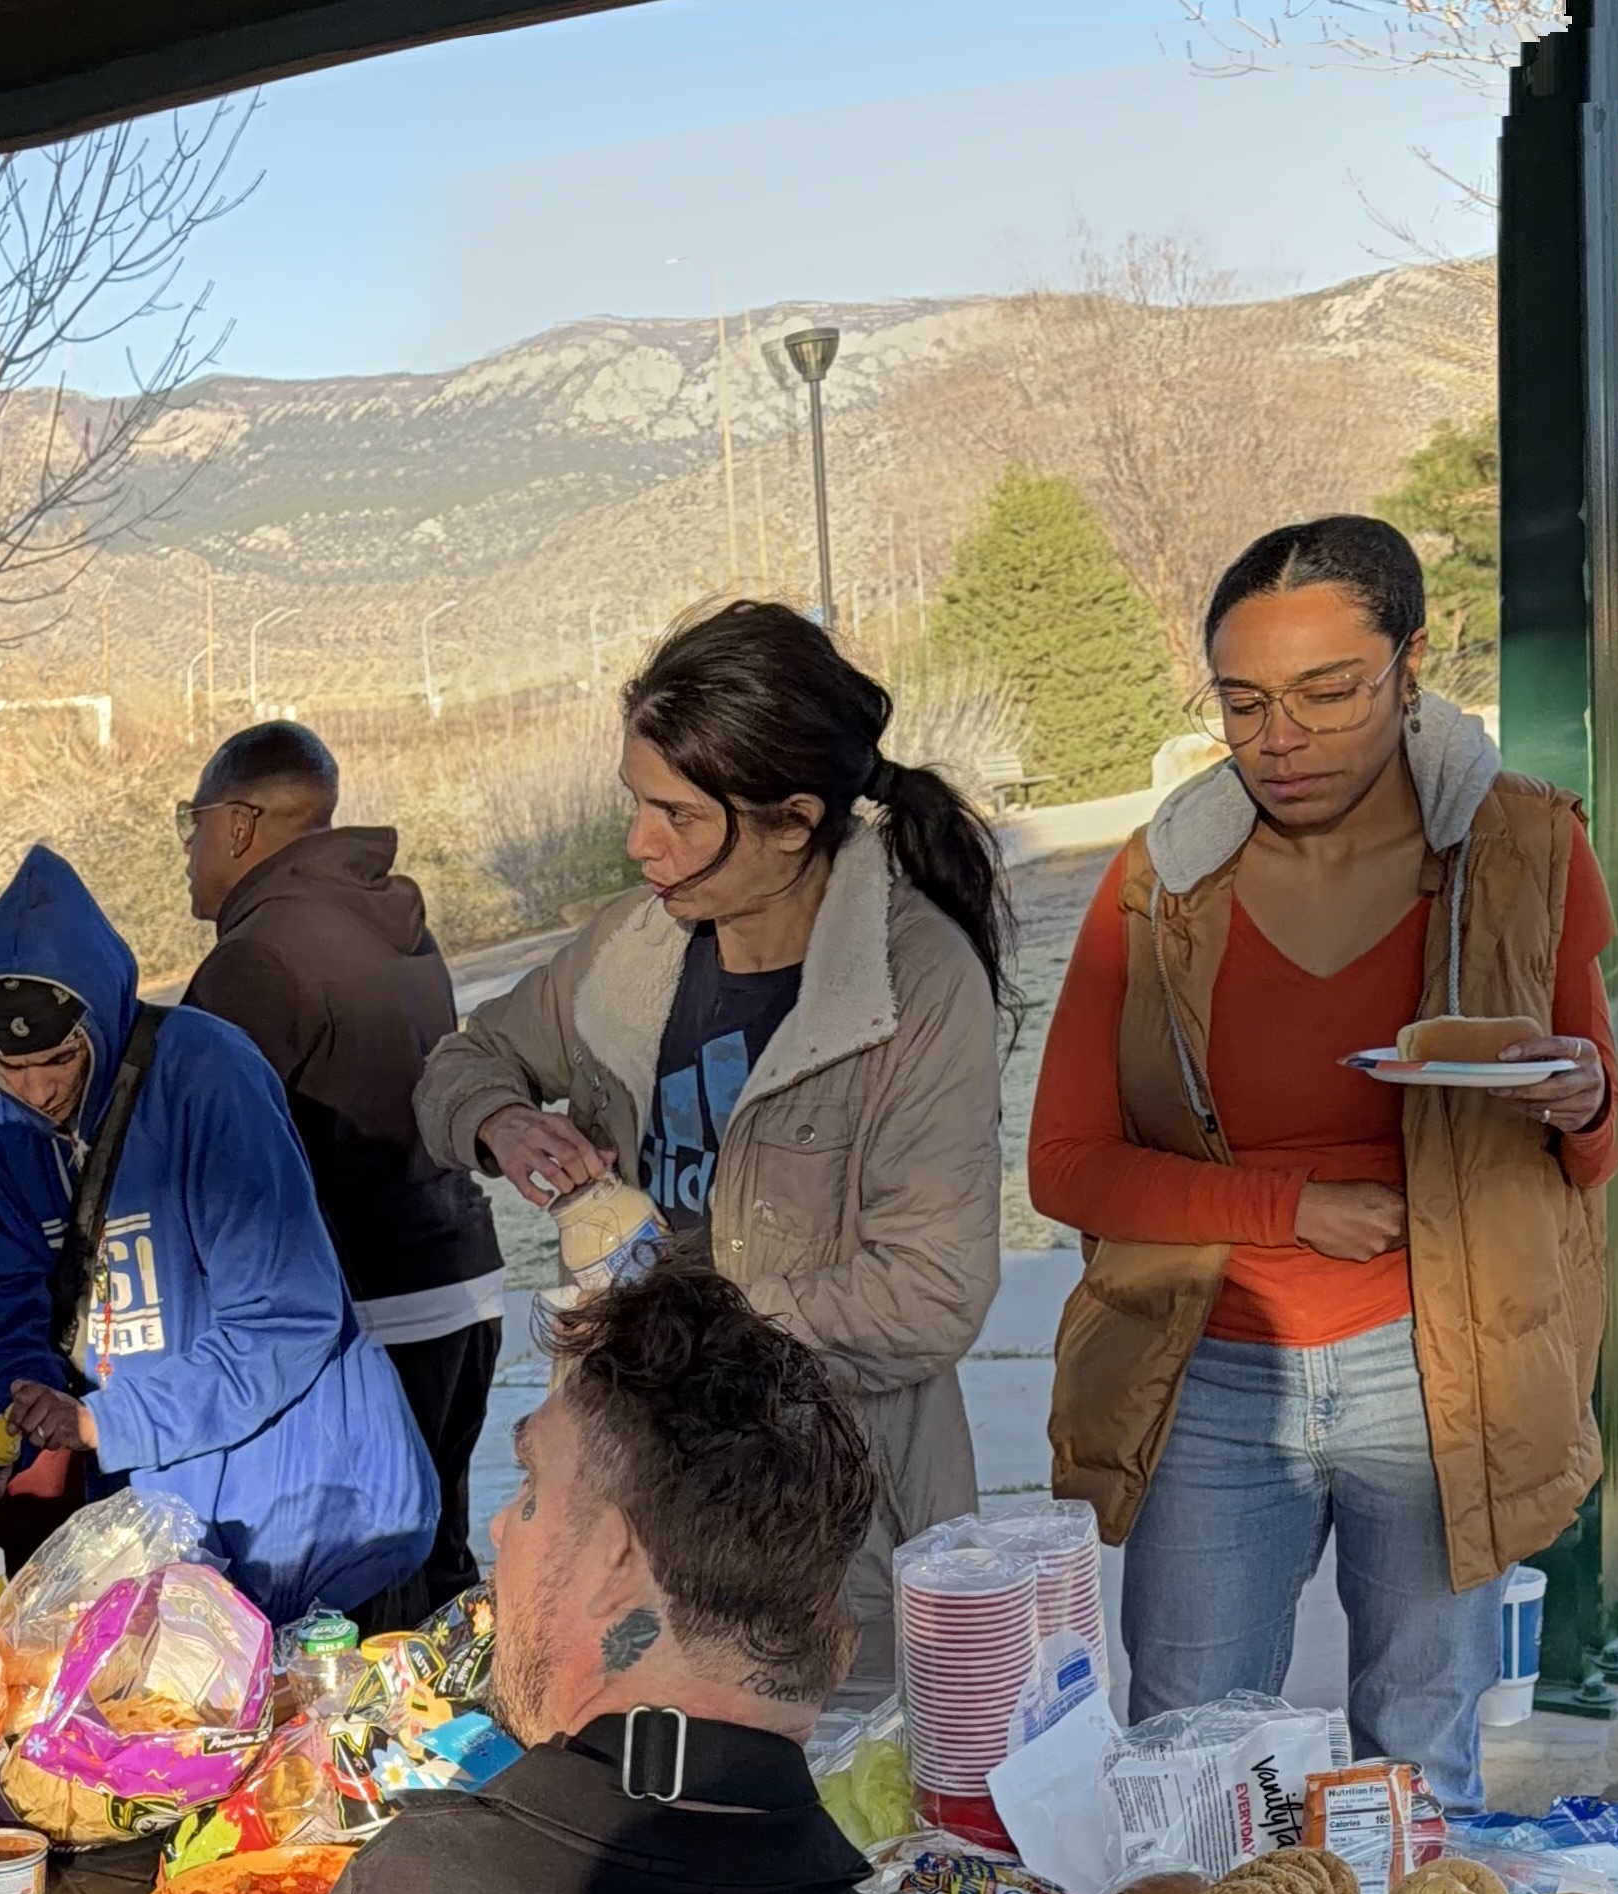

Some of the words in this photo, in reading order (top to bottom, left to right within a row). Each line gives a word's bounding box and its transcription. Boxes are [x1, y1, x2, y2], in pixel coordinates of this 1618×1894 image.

[1328, 1787, 1368, 1798] Nutrition
[1235, 1782, 1257, 1855] EVERYDAY
[1329, 1820, 1361, 1829] Calories
[1375, 1814, 1391, 1825] 160
